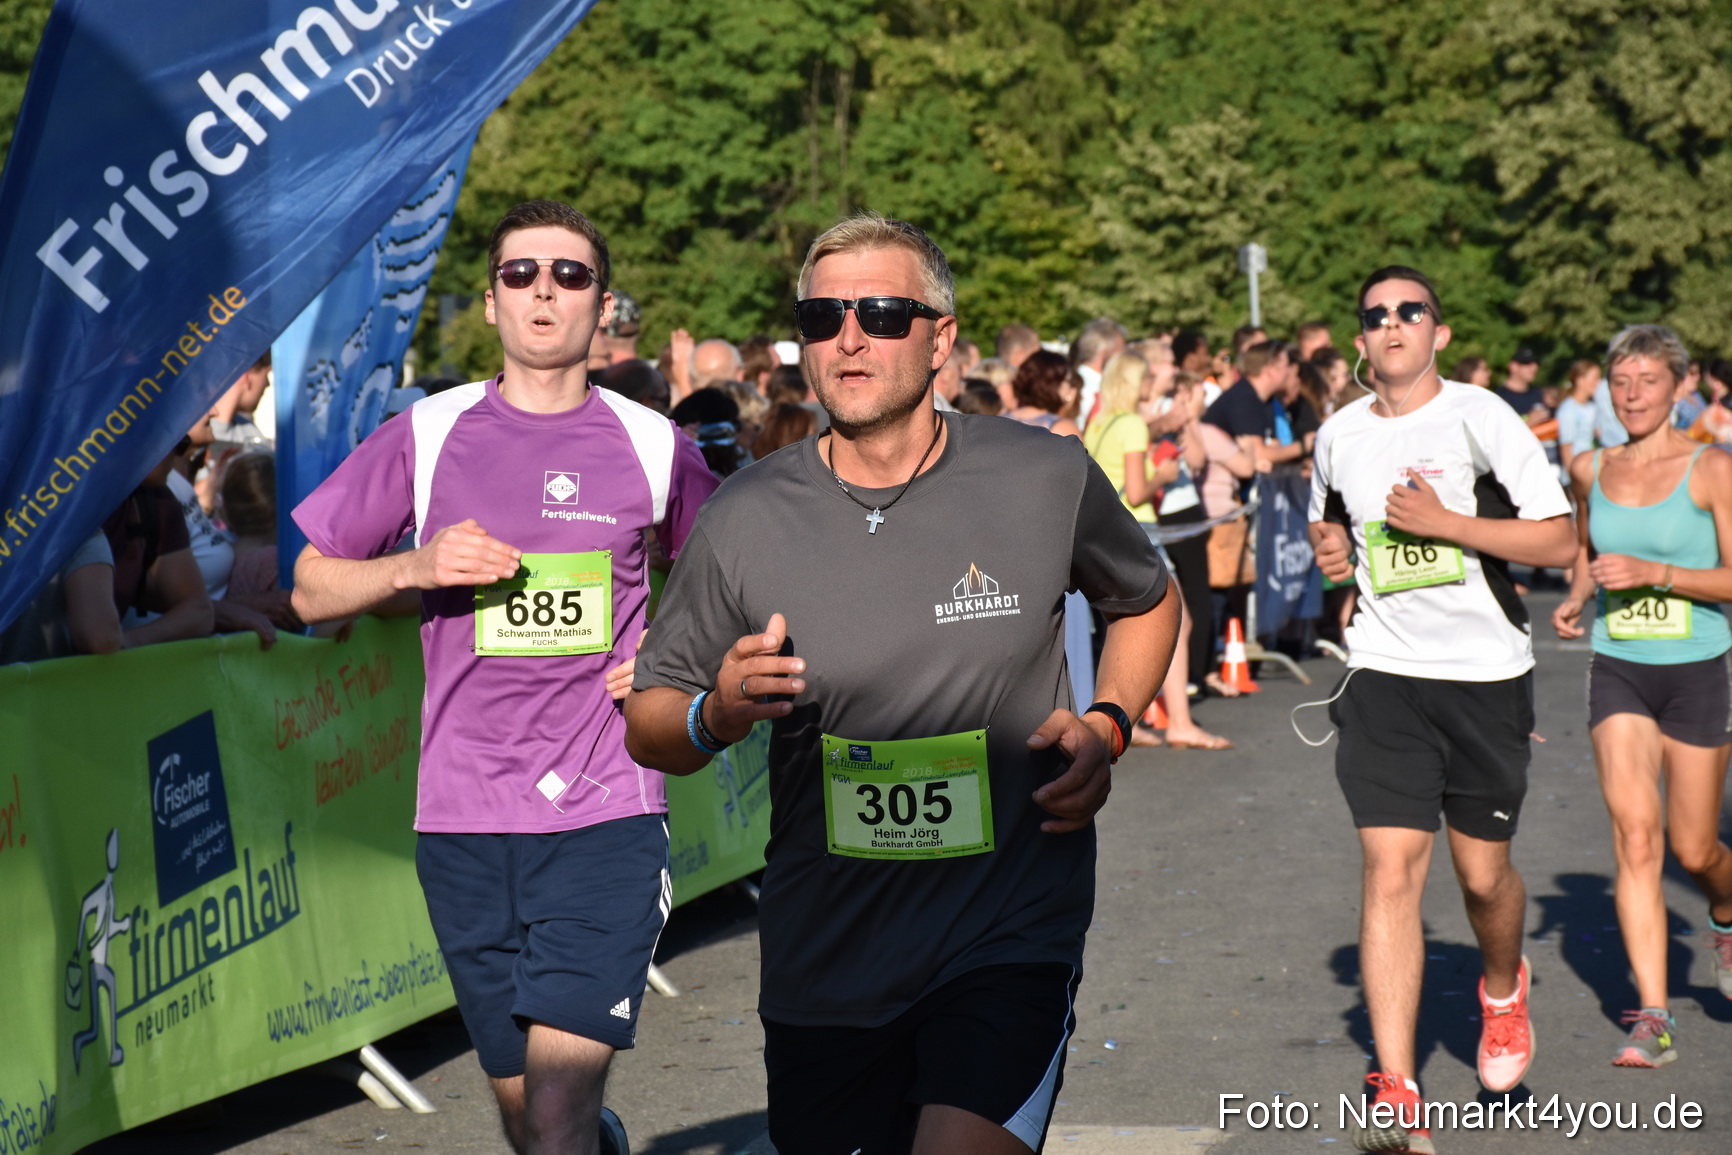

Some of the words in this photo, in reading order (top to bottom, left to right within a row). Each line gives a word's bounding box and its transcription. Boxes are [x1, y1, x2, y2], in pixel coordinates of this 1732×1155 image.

[344, 4, 452, 109] Druck
[541, 509, 617, 525] Fertigteilwerke
[1386, 540, 1438, 569] 766
[545, 577, 572, 586] 2018
[506, 590, 583, 627] 685
[934, 595, 1020, 617] BURKHARDT
[936, 615, 962, 625] ENERGIE-
[962, 613, 975, 621] UND
[975, 608, 1021, 619] GEBÄUDETECHNIK
[1621, 598, 1669, 621] 340
[497, 628, 551, 638] Schwamm
[553, 627, 593, 637] Mathias
[839, 757, 895, 771] firmenlauf
[902, 766, 934, 778] 2018
[163, 770, 211, 815] Fischer
[856, 780, 953, 826] 305
[170, 799, 211, 831] AUTOMOBILE
[871, 840, 915, 848] Burkhardt
[916, 839, 943, 848] GmbH
[873, 828, 906, 839] Heim
[910, 827, 939, 840] Jörg
[129, 820, 300, 1005] firmenlauf
[136, 971, 216, 1048] neumarkt
